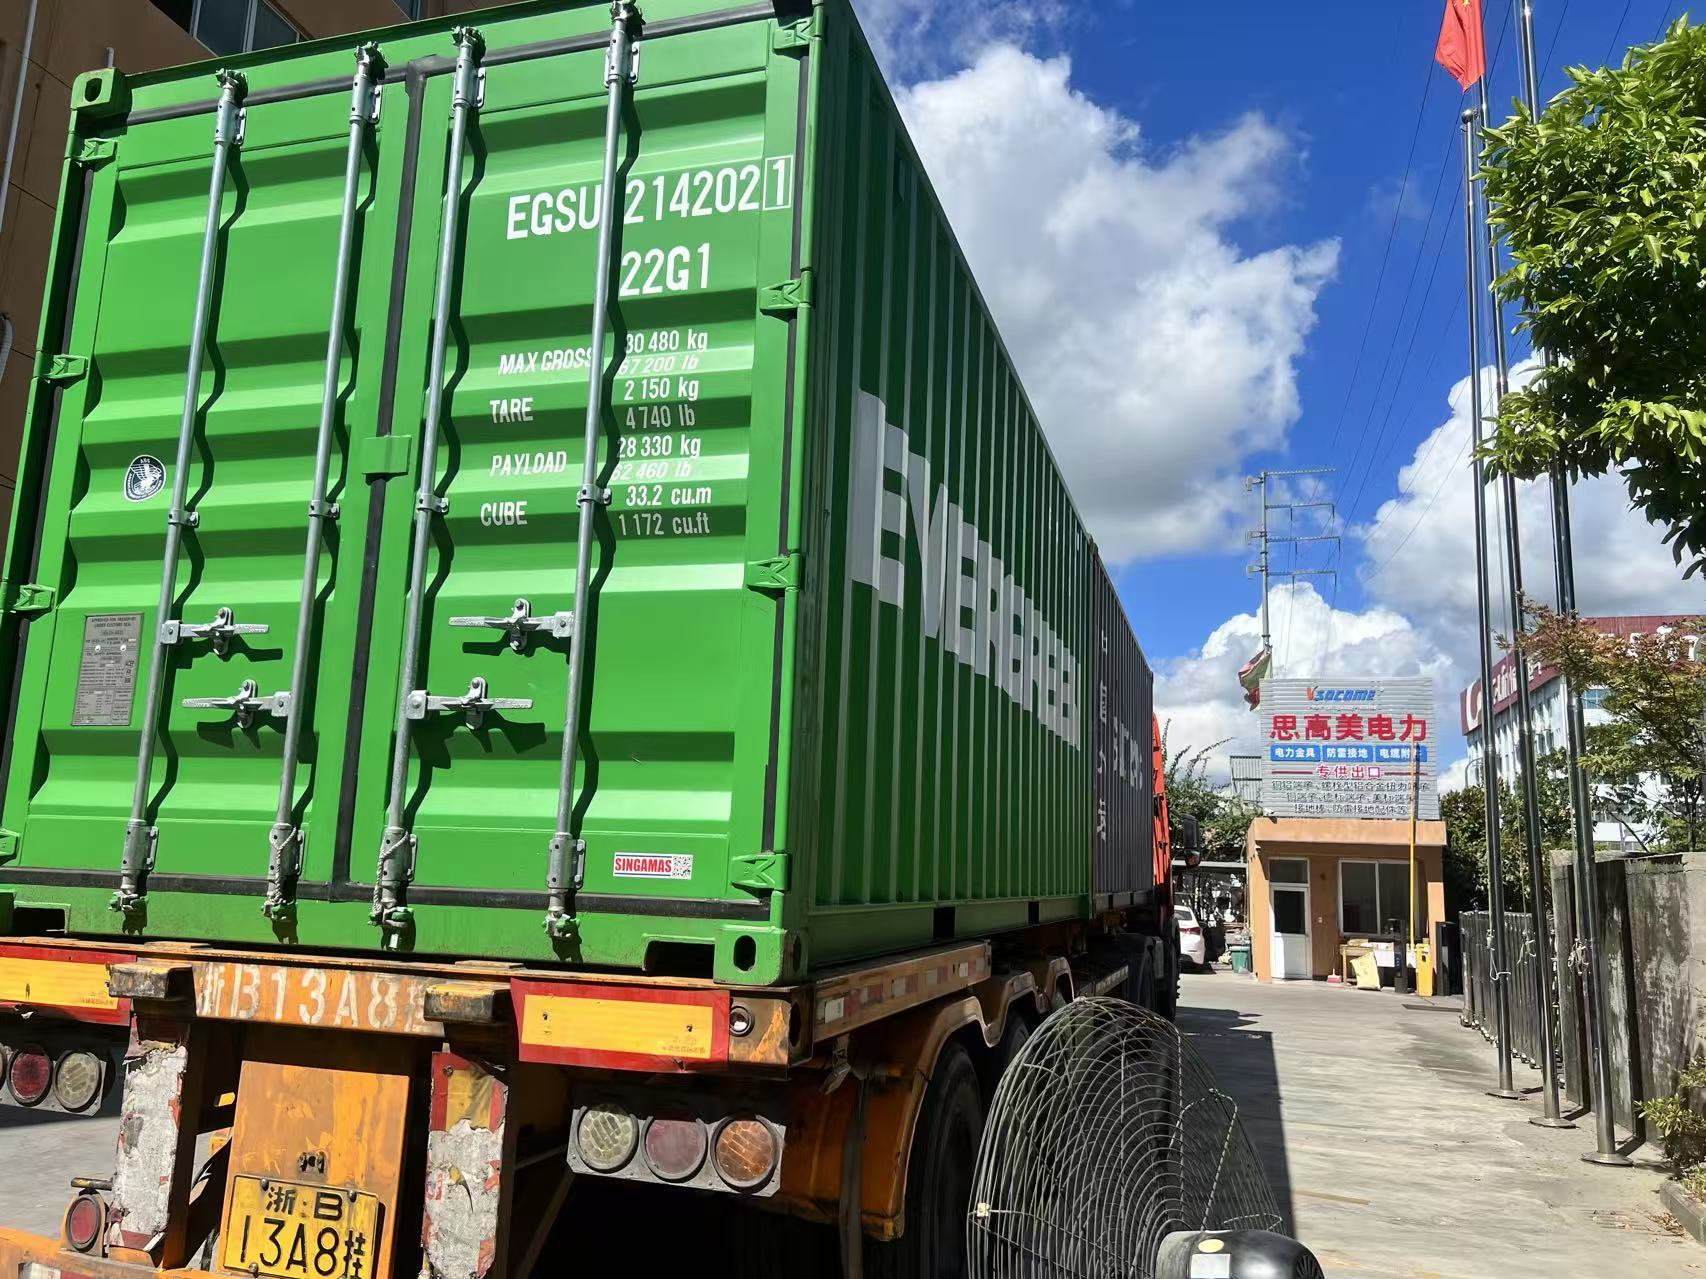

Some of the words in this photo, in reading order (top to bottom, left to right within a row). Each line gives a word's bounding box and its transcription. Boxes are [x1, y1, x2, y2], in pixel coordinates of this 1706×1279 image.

[507, 184, 602, 240] EGSU
[624, 164, 760, 225] 214202
[619, 242, 710, 297] 22G1
[648, 330, 680, 352] 480
[687, 329, 708, 352] kg
[498, 352, 538, 375] MAX
[541, 348, 594, 370] GROSS
[642, 356, 675, 374] 200
[681, 354, 699, 370] lb
[624, 380, 635, 400] 2
[641, 378, 670, 399] 150
[678, 376, 699, 401] kg
[490, 397, 534, 424] TARE
[625, 407, 636, 429] 4
[638, 405, 671, 428] 740
[679, 403, 695, 427] lb
[617, 436, 637, 458] 28
[641, 434, 672, 457] 330
[680, 434, 701, 459] kg
[490, 451, 567, 477] PAYLOAD
[635, 461, 668, 478] 460
[674, 460, 692, 476] lb
[626, 484, 662, 507] 33.2
[671, 485, 712, 506] cu.m
[480, 501, 528, 526] CUBE
[619, 513, 628, 536] 1
[632, 513, 664, 535] 172
[672, 512, 710, 535] cu.ft
[850, 389, 1081, 751] EVERGREEN
[1269, 713, 1427, 742] 思高美电力
[1275, 747, 1315, 758] 电力金具
[1317, 765, 1381, 780] 专供出口
[615, 857, 672, 873] SINGAMAS
